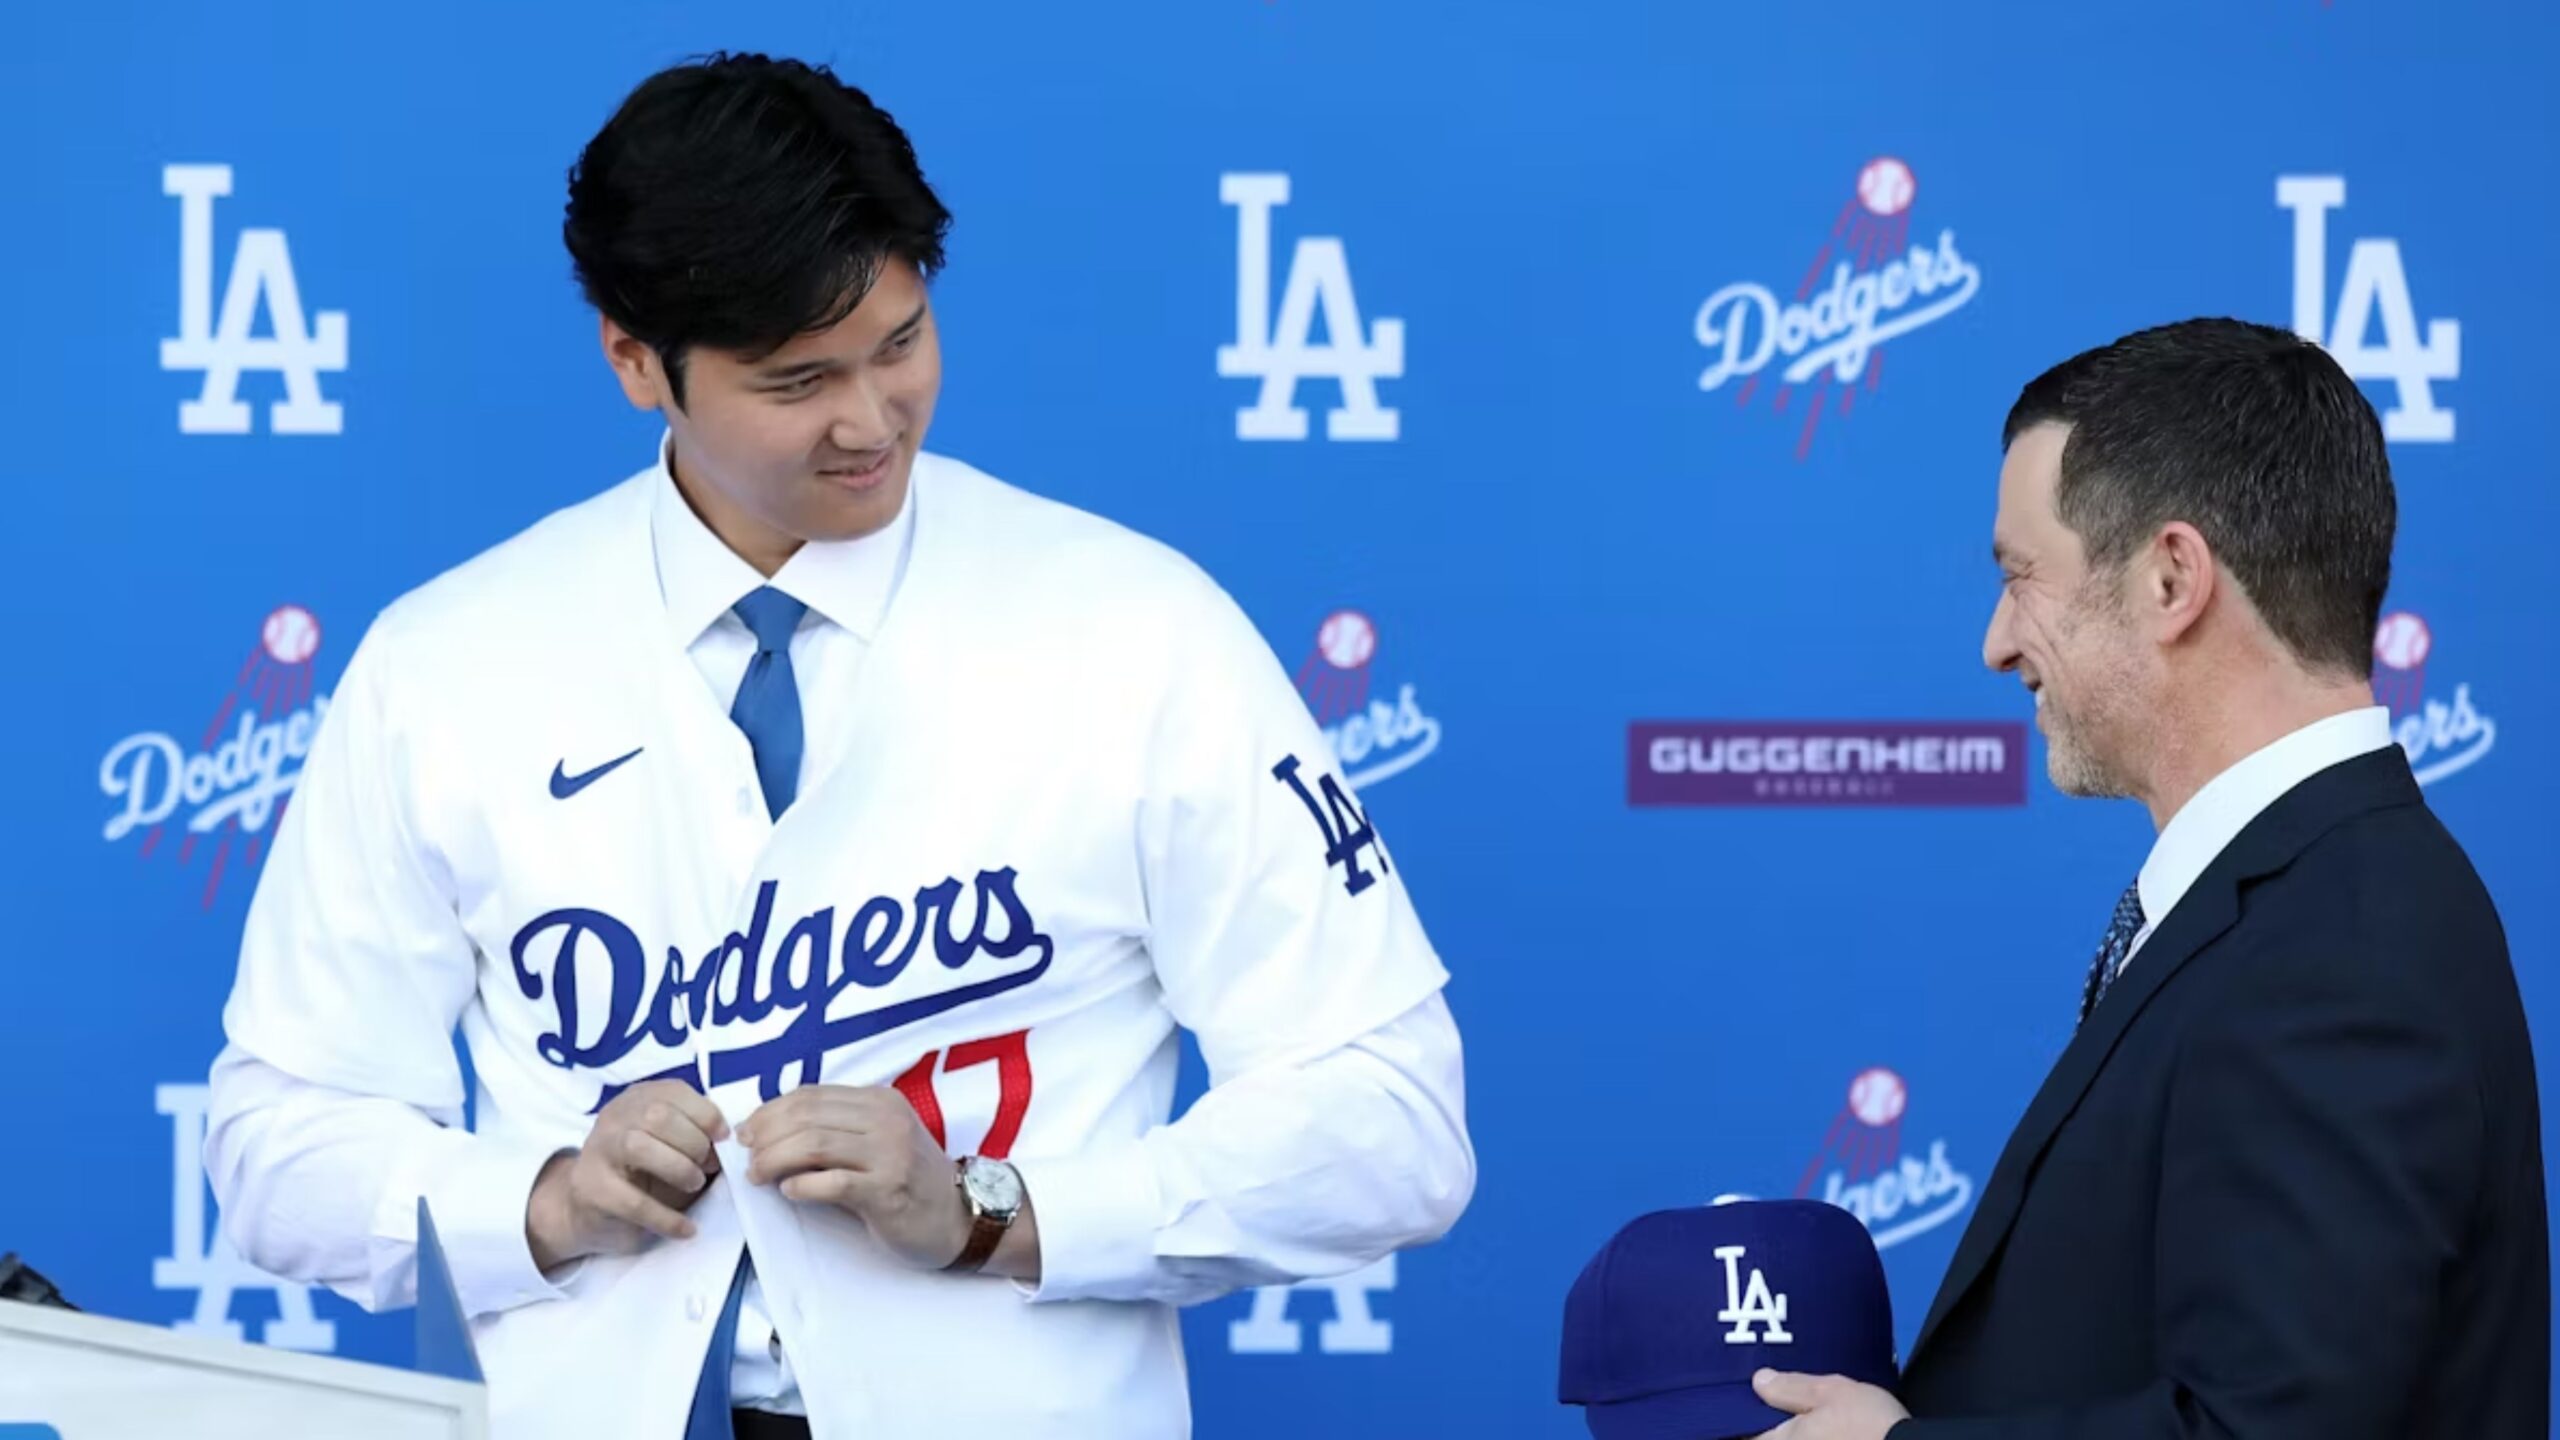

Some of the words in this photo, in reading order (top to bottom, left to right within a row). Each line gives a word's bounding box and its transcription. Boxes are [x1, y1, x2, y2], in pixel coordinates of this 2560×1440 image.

[160, 163, 348, 434] LA
[1217, 172, 1405, 441] LA
[1693, 227, 1981, 392] Dodgers
[2275, 175, 2461, 443] LA
[98, 694, 333, 842] Dodge
[1271, 752, 1389, 897] LA
[1649, 737, 2005, 773] GUGGENHEIM
[510, 864, 1054, 1115] Dodgers
[891, 1028, 1035, 1159] 17
[1714, 1245, 1794, 1343] LA
